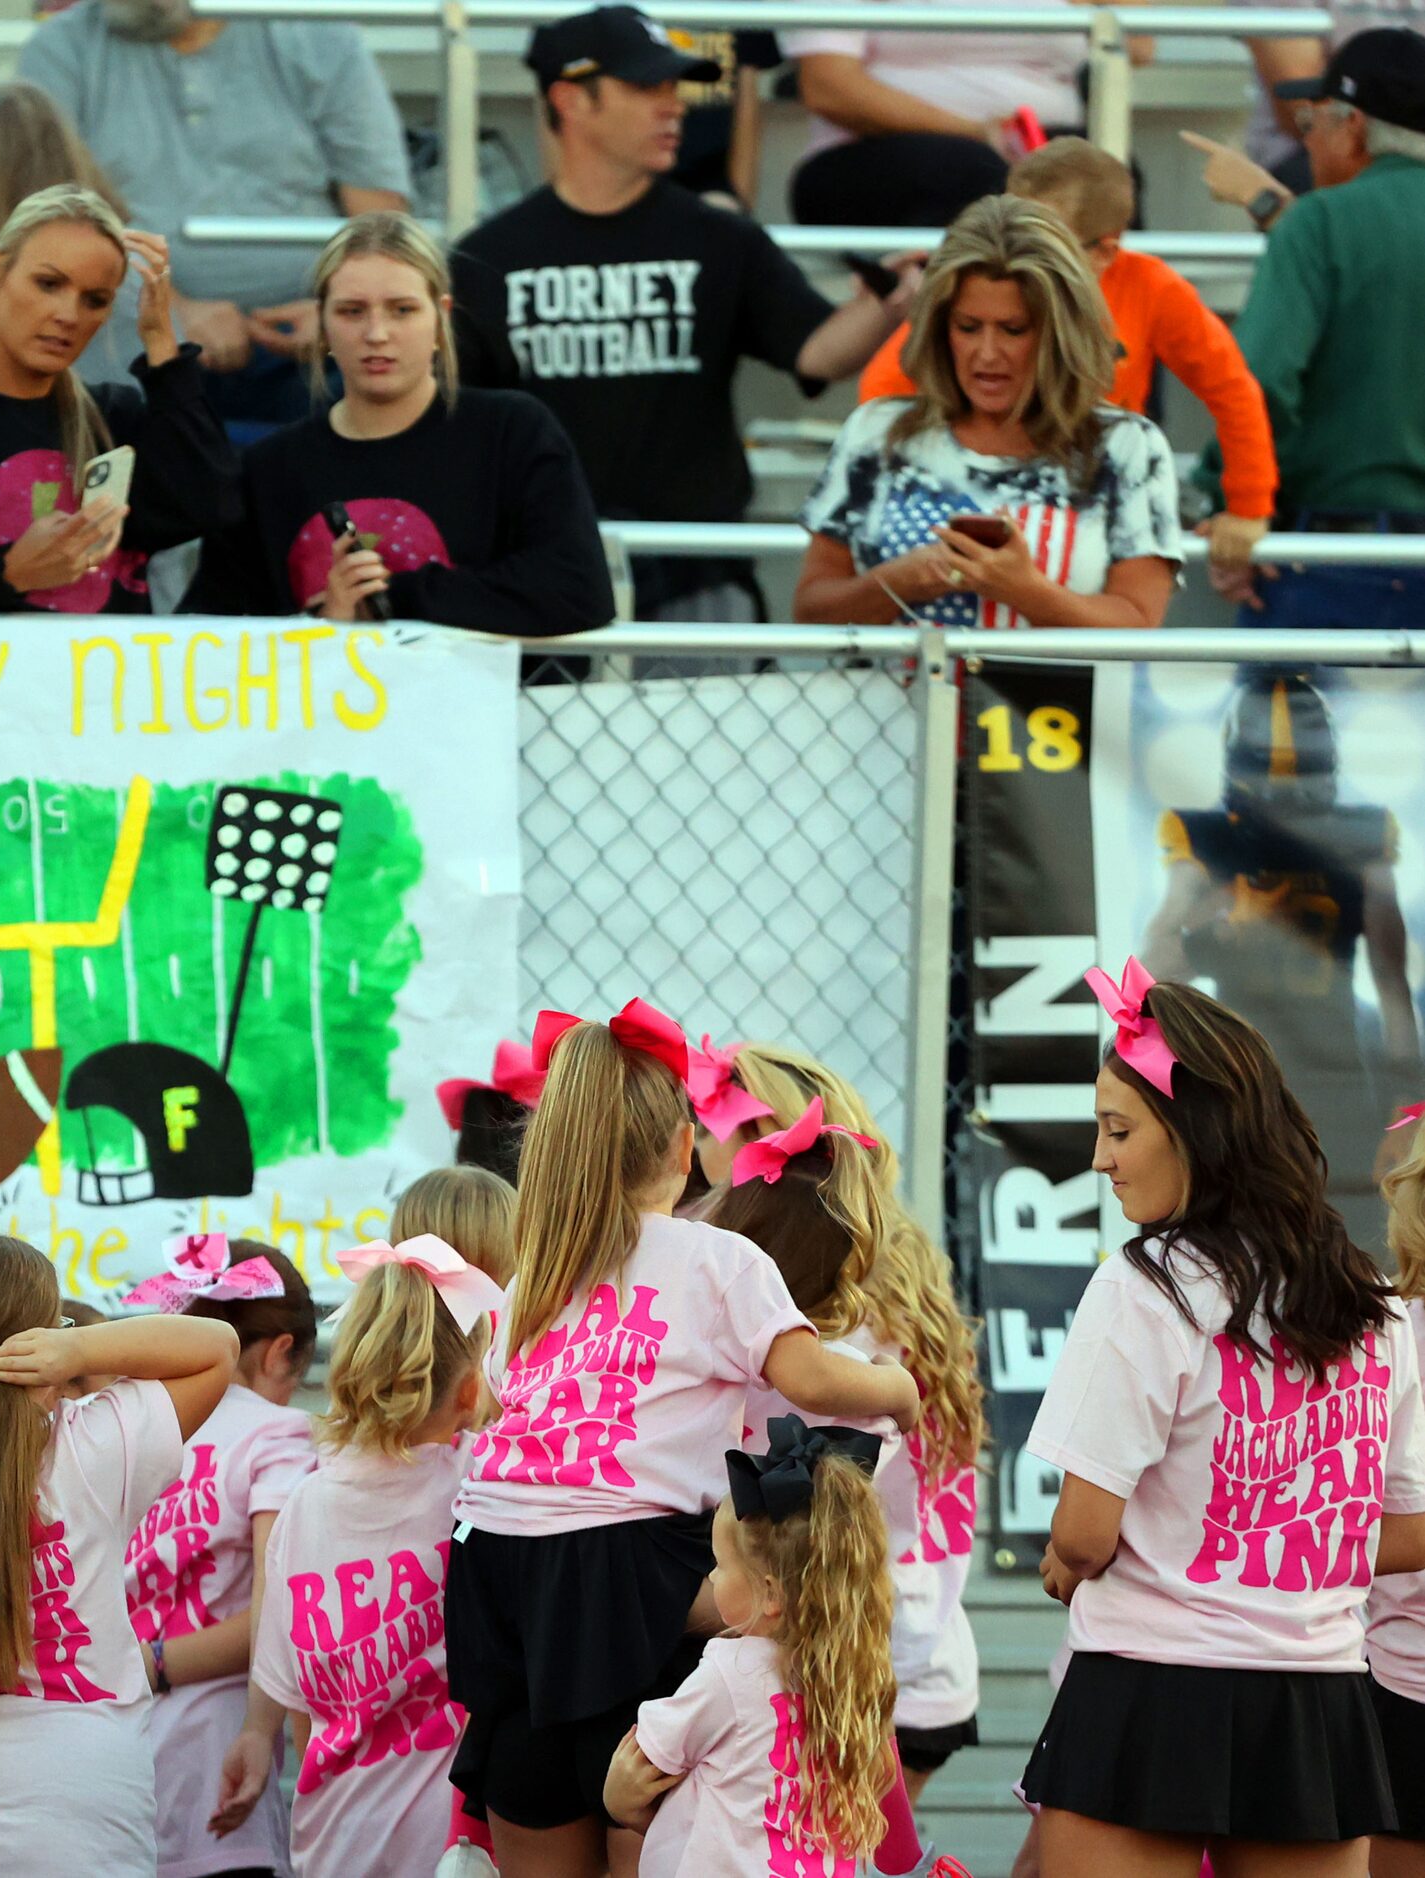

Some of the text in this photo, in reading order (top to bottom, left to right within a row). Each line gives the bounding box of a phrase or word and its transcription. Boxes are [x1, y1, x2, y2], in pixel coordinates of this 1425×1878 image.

[505, 260, 702, 327] FORNEY
[508, 316, 702, 381] FOOTBALL
[977, 705, 1083, 772] 18
[163, 1085, 200, 1153] F
[1213, 1386, 1389, 1481] JACKRABBITS
[1205, 1437, 1383, 1532] WEAR
[1185, 1500, 1383, 1592] PINK
